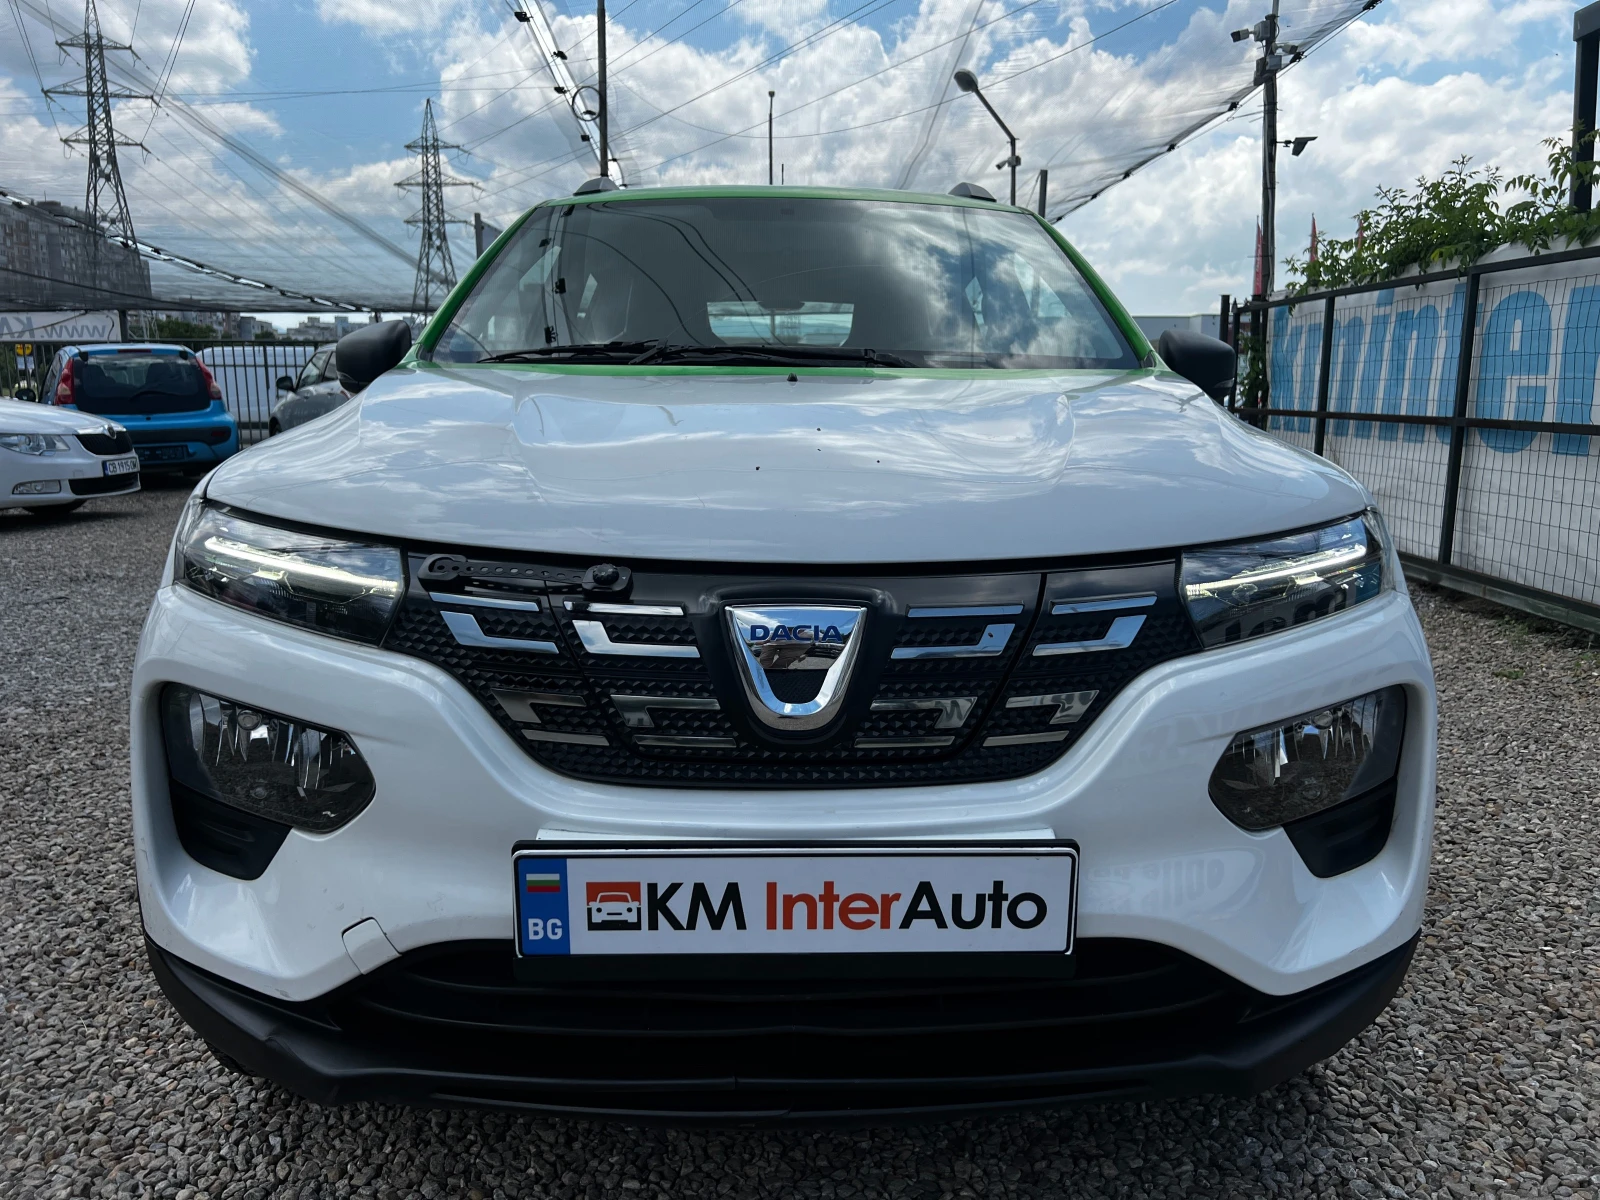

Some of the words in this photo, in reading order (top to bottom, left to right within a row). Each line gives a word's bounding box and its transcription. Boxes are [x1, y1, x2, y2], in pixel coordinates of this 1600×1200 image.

[750, 624, 844, 644] DACIA
[647, 882, 748, 931] KM
[766, 880, 1048, 931] InterAuto
[528, 918, 563, 941] BG
